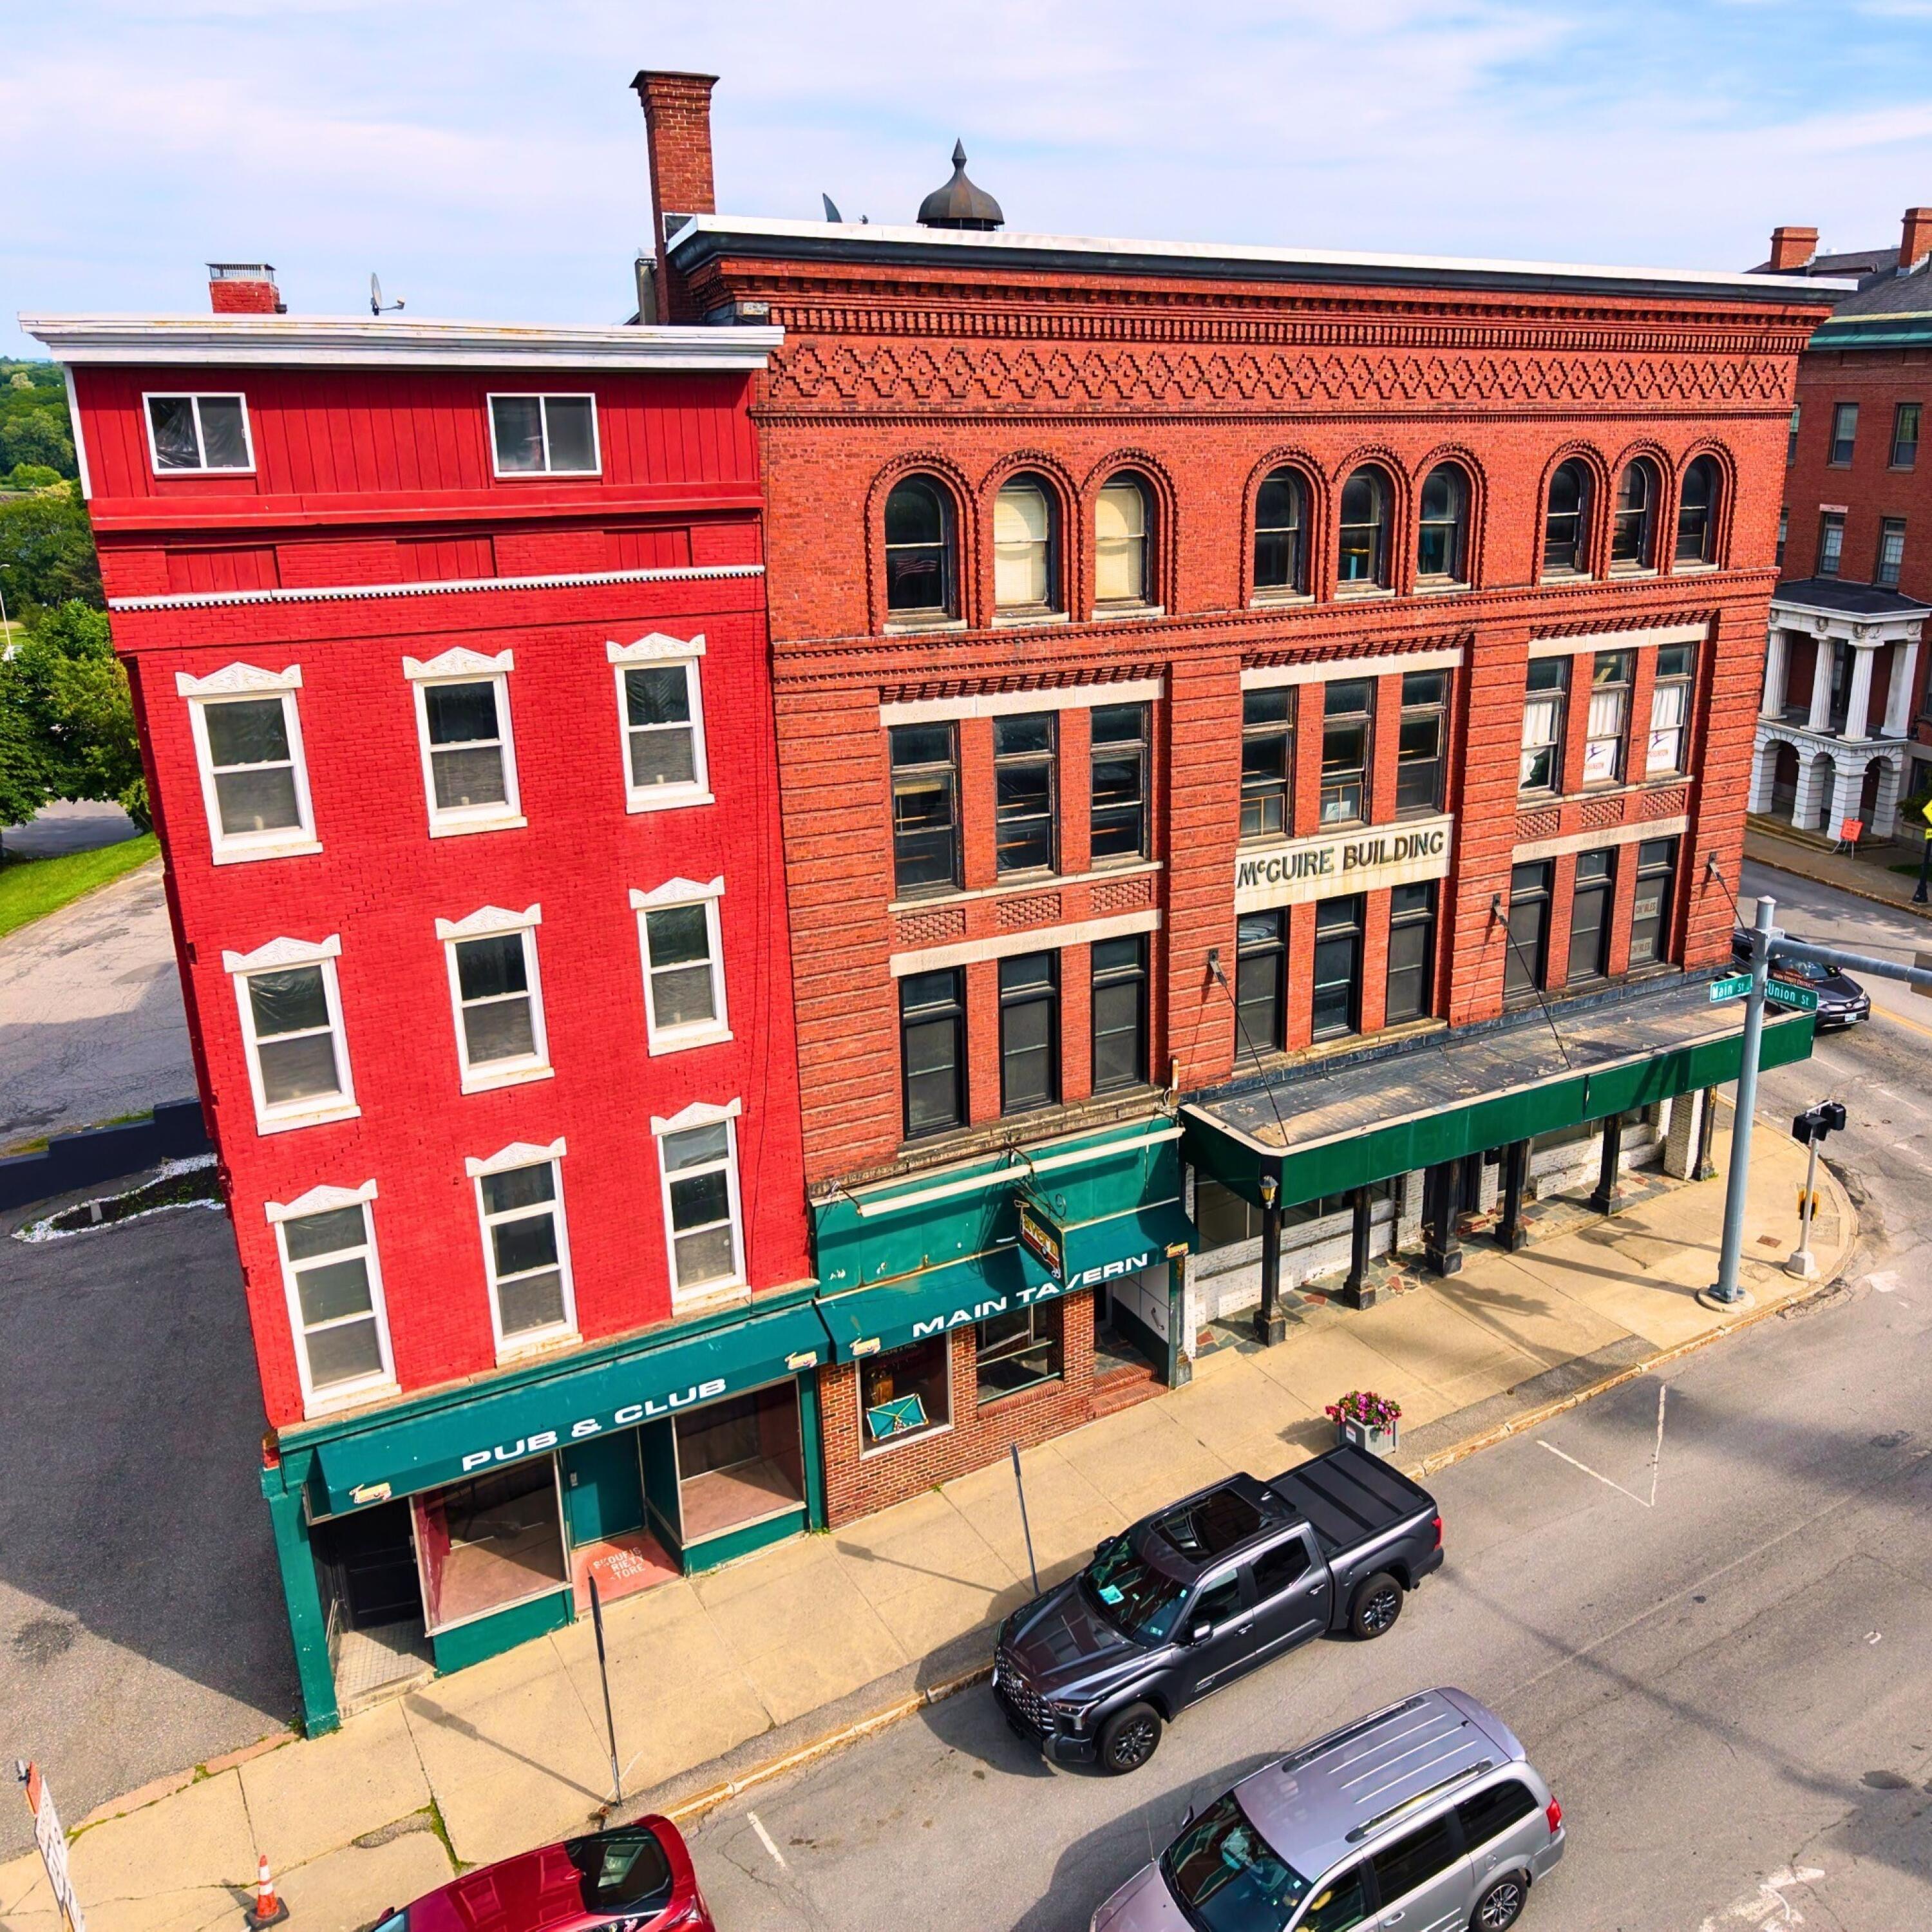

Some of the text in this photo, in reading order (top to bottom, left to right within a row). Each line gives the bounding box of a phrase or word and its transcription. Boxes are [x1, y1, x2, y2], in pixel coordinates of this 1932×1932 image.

[1236, 831, 1444, 889] McGUIRE BUILDING
[1712, 982, 1745, 999] Main St
[1768, 982, 1809, 1005] Union St
[913, 1296, 1008, 1338] MAIN
[462, 1379, 726, 1472] PUB & CLUB
